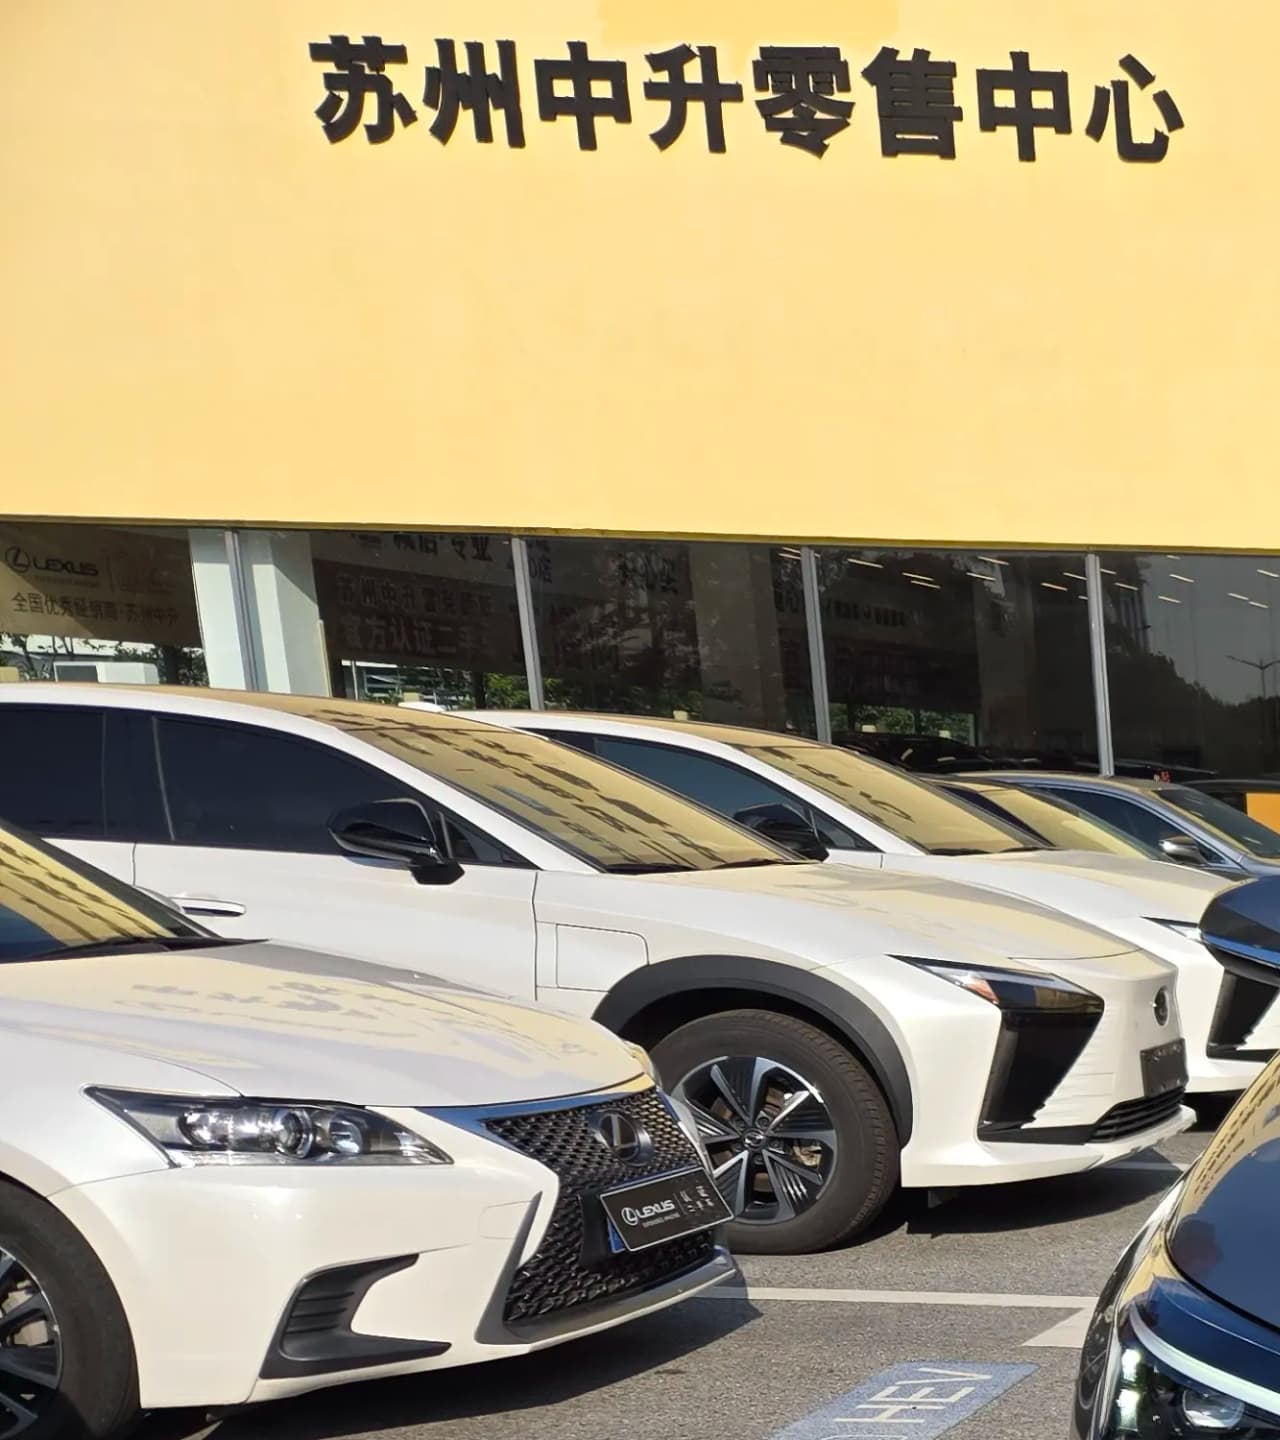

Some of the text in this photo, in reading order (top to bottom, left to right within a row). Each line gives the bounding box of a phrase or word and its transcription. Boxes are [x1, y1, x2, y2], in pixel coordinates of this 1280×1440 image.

[308, 35, 1185, 164] 苏州中升零售中心
[637, 1199, 676, 1218] LEXUS
